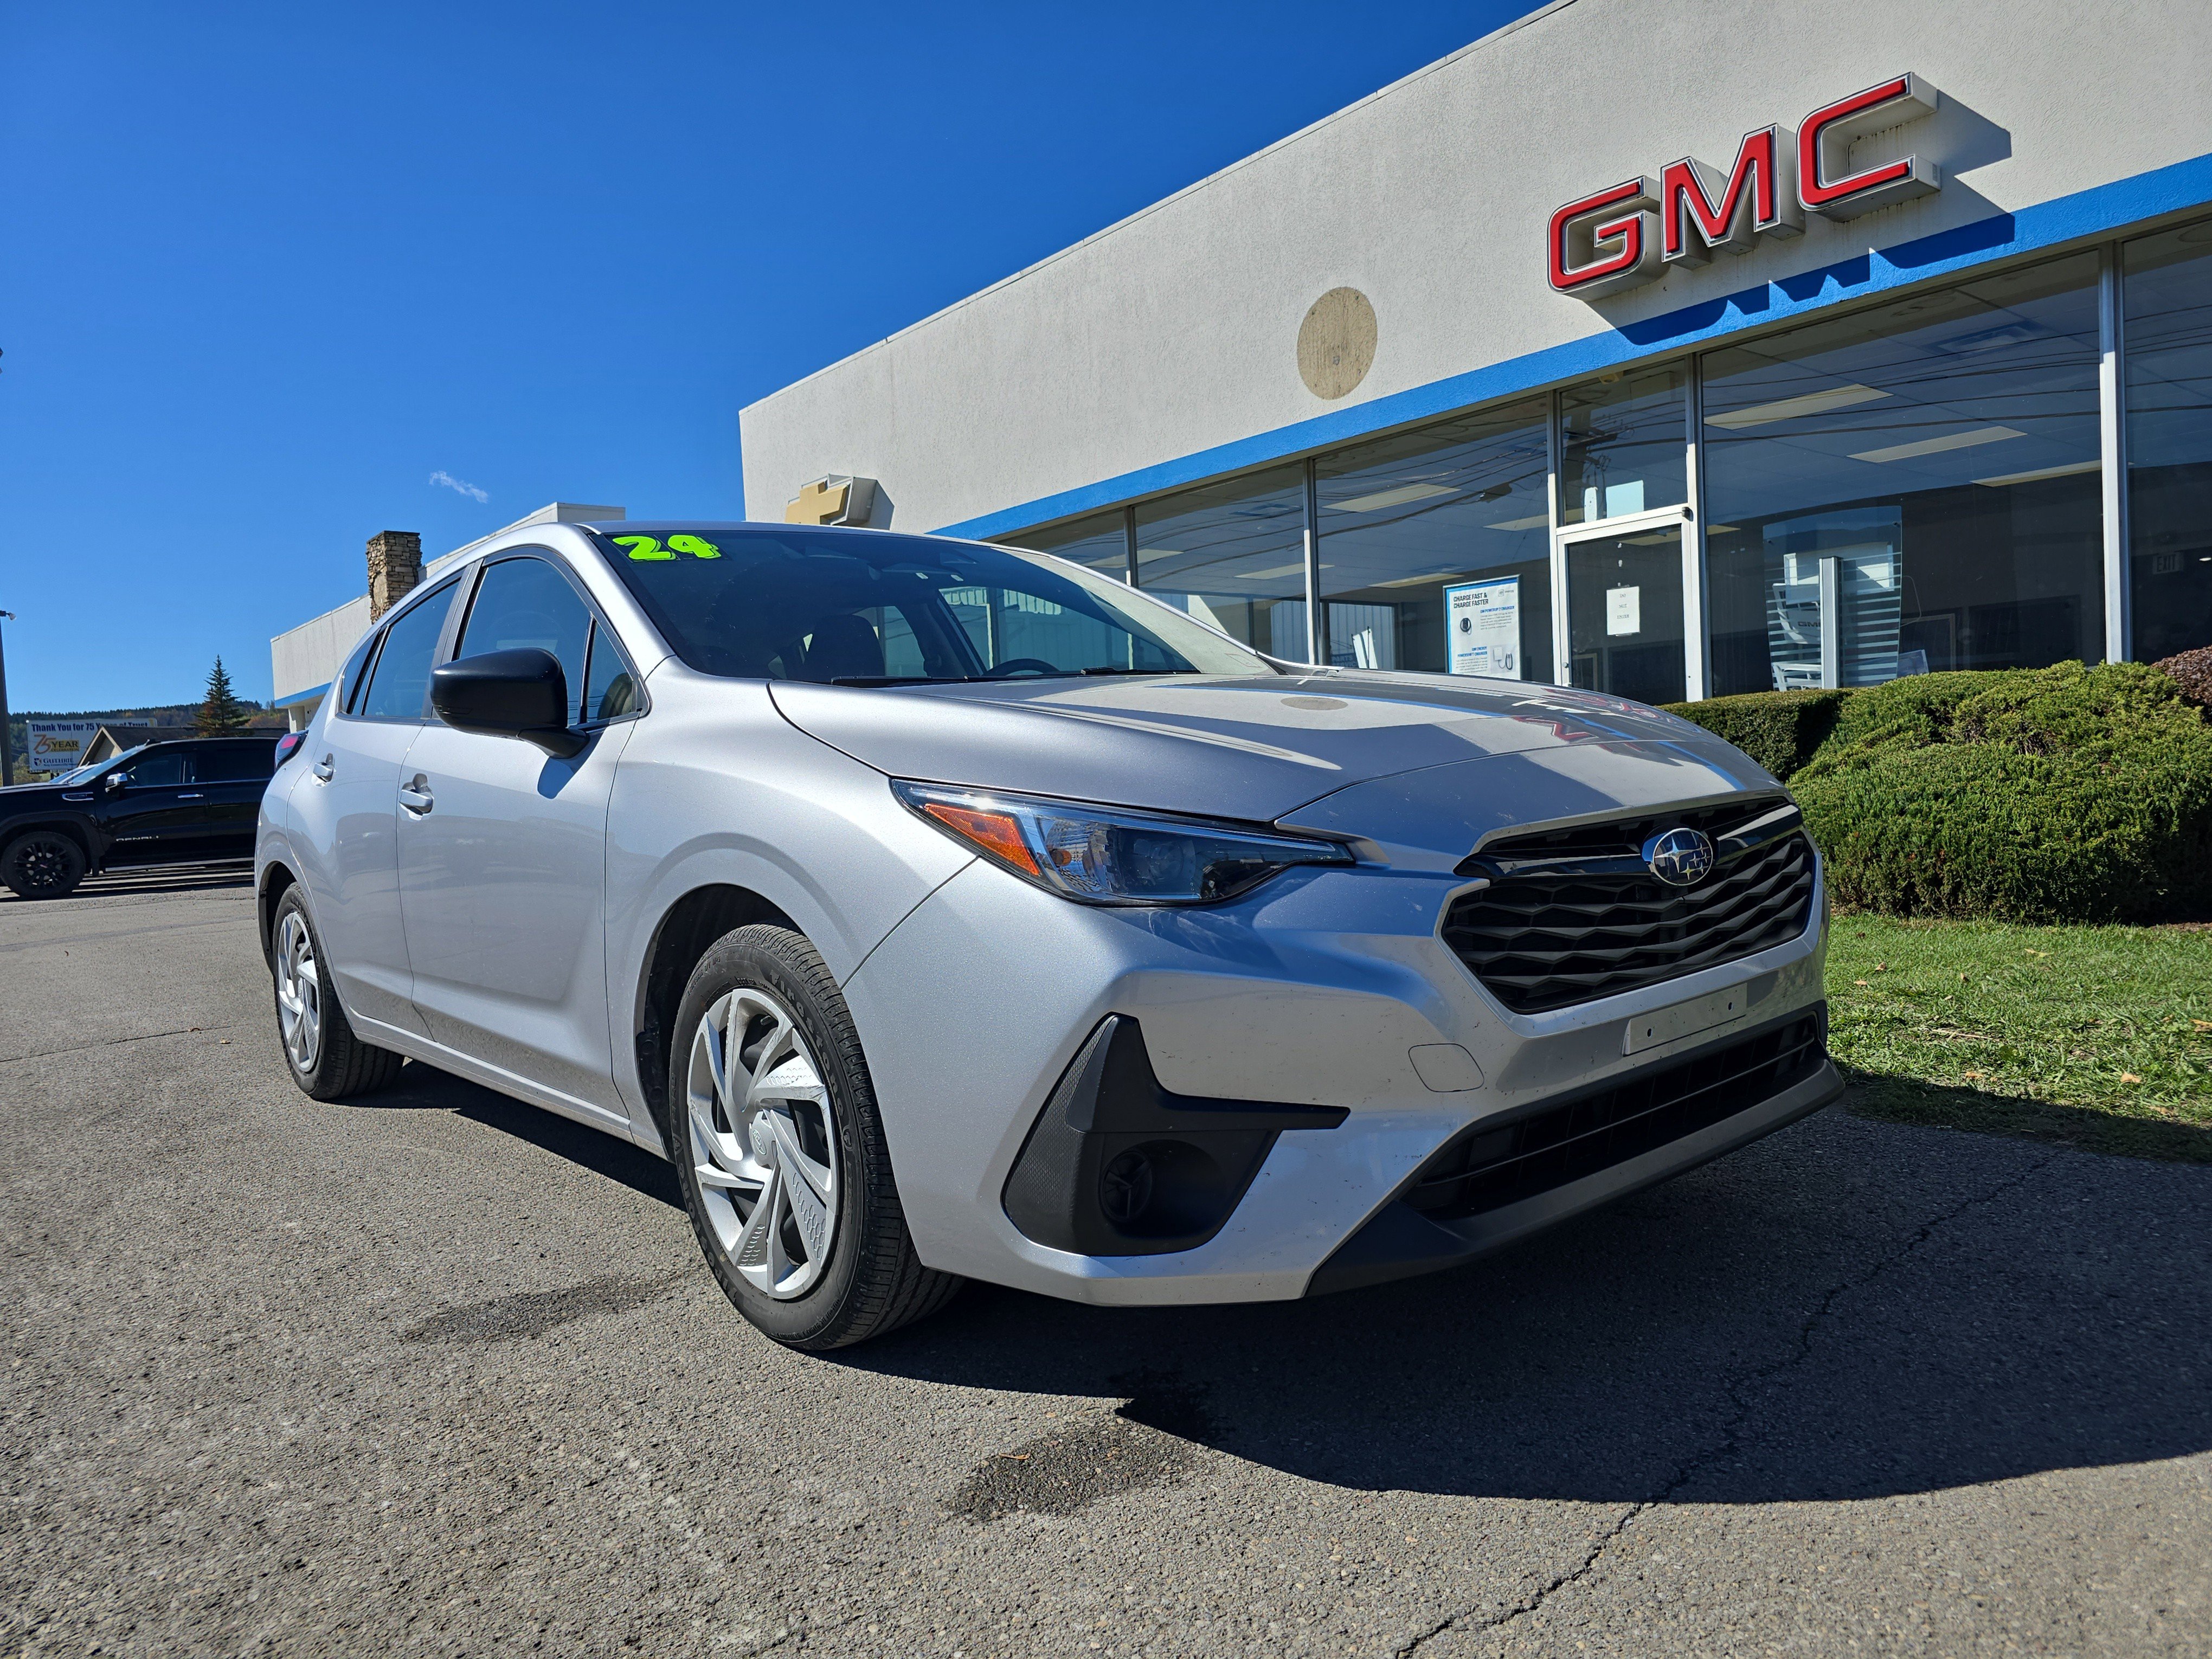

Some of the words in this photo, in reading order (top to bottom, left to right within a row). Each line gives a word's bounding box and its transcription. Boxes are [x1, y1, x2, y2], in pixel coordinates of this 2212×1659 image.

[1547, 72, 1917, 294] GMC
[612, 535, 722, 561] 24
[31, 724, 56, 732] Thank
[57, 723, 71, 731] You
[73, 723, 84, 731] for
[86, 722, 95, 731] 75
[52, 740, 79, 748] YEAR
[769, 968, 844, 1117] Firestone
